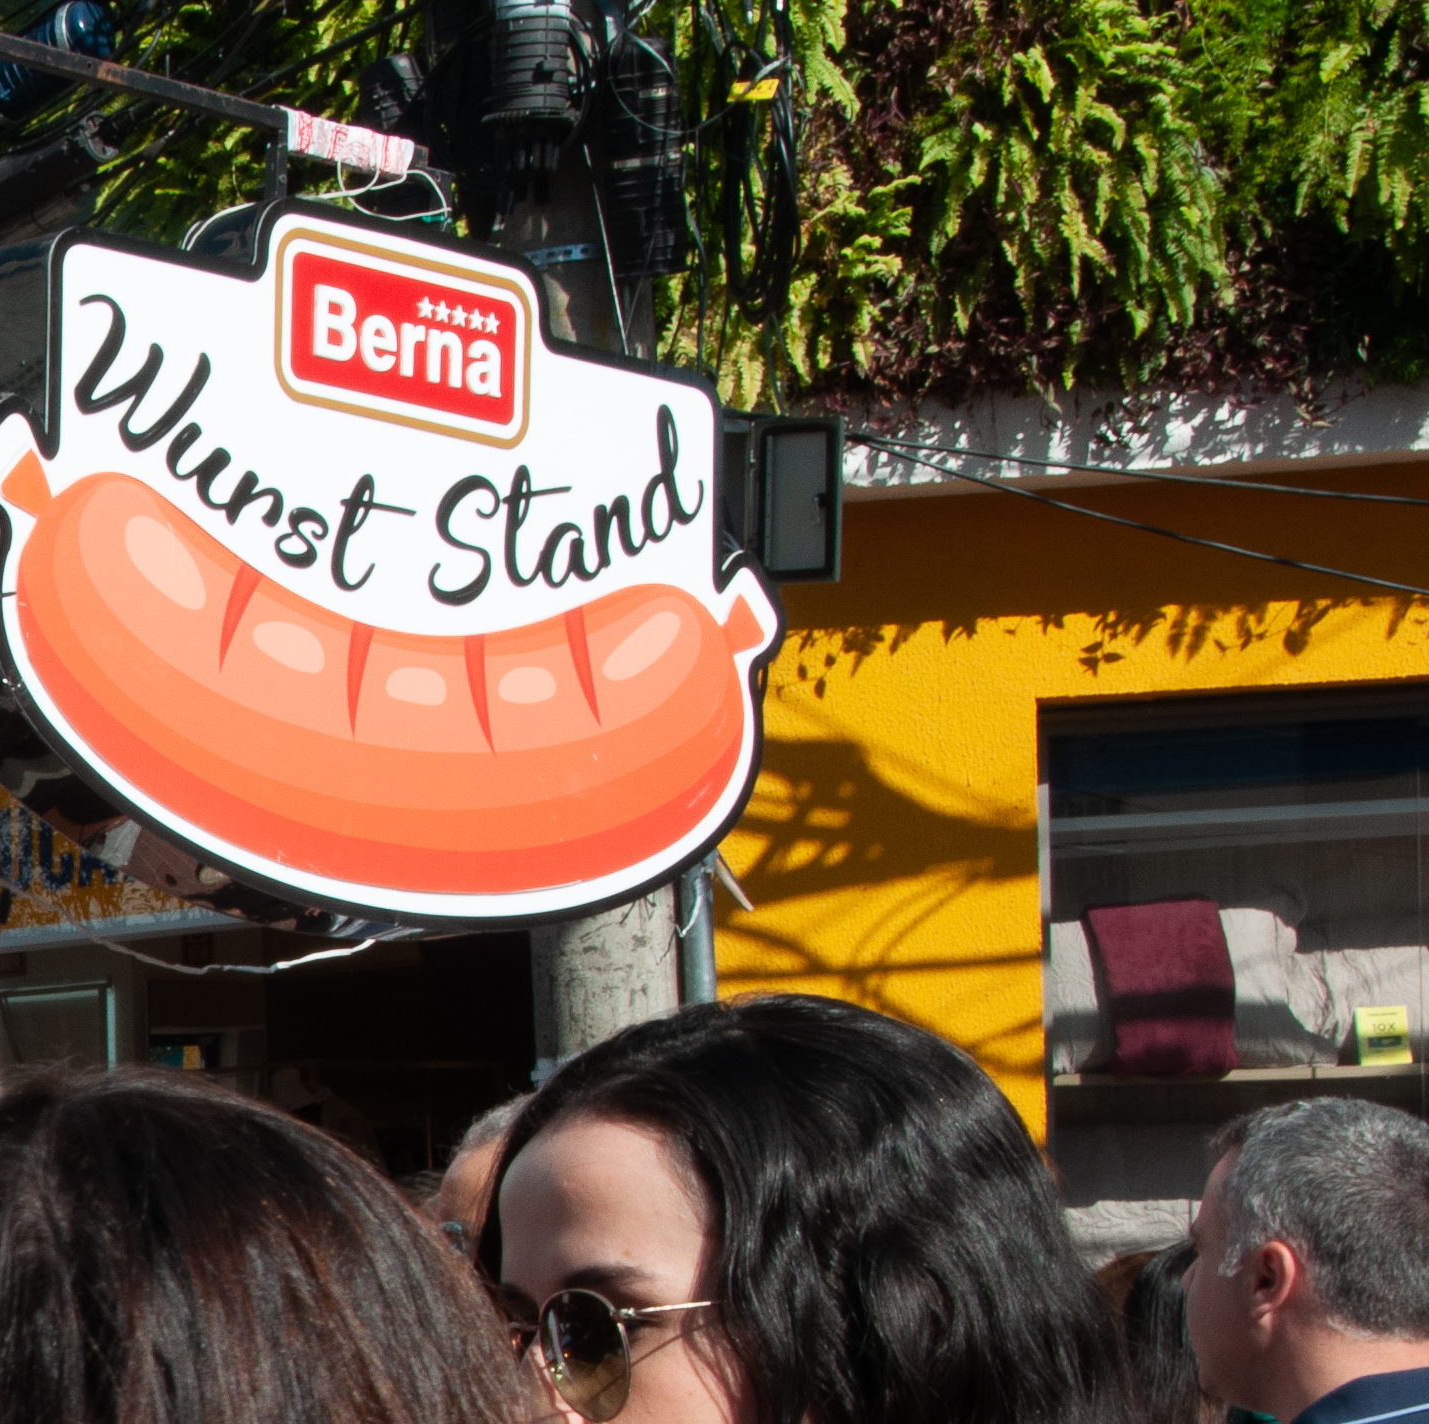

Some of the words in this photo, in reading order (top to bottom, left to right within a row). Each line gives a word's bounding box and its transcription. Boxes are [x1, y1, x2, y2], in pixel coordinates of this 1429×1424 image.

[313, 284, 502, 399] Berna
[73, 293, 416, 592] Wurst
[428, 404, 704, 606] Stand
